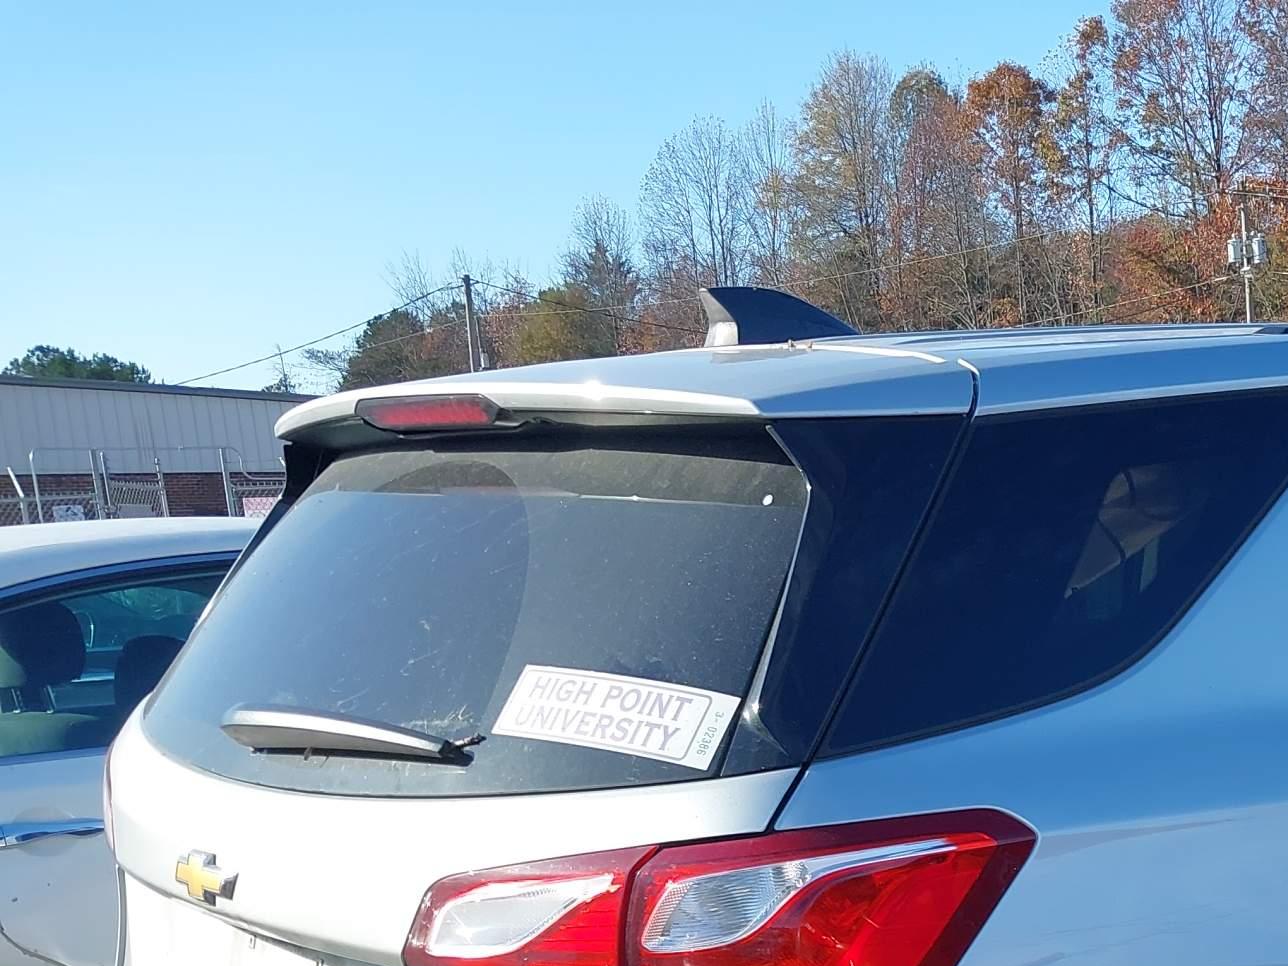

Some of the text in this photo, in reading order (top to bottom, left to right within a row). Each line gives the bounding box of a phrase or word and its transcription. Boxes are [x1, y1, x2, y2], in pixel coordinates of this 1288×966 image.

[528, 676, 694, 721] HIGH POINT
[514, 704, 681, 751] UNIVERSITY
